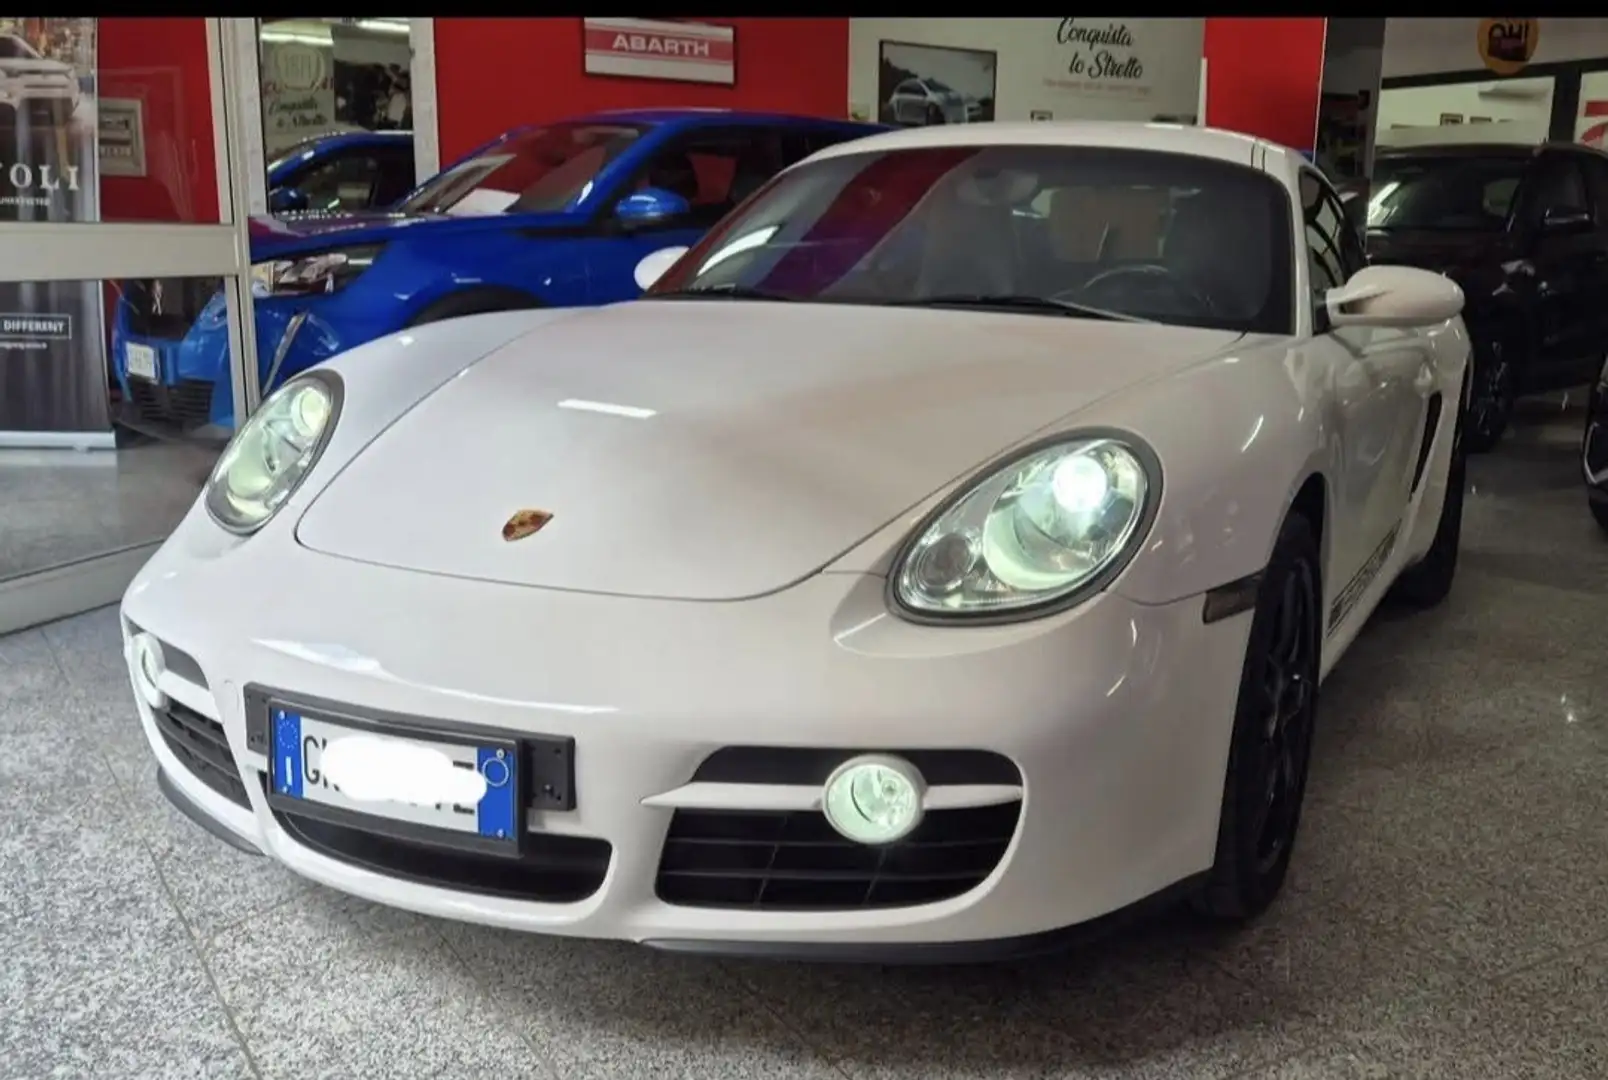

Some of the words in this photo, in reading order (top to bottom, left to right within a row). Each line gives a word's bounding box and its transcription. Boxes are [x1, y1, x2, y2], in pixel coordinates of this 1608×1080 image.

[612, 34, 709, 56] ABARTH
[1057, 17, 1132, 51] Conquista
[1069, 52, 1085, 74] lo
[1088, 51, 1144, 79] Stretto
[0, 162, 80, 191] OLI
[3, 319, 65, 333] DIFFERENT
